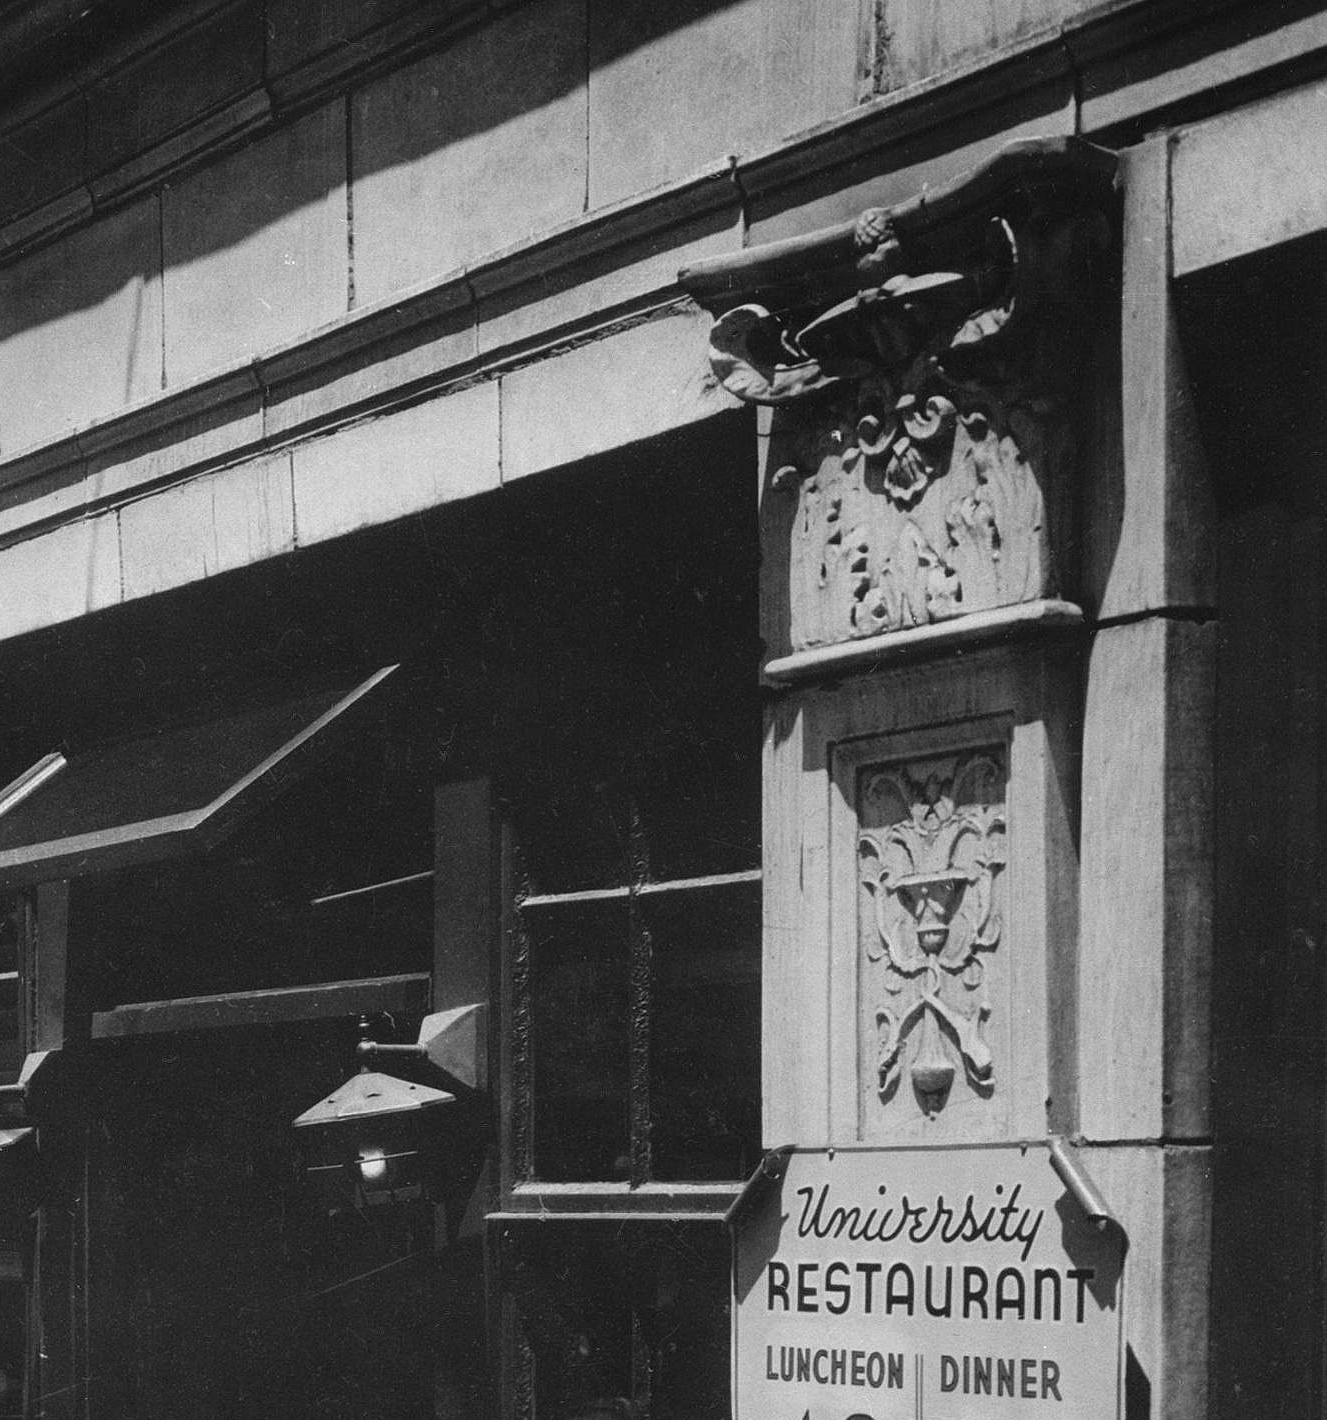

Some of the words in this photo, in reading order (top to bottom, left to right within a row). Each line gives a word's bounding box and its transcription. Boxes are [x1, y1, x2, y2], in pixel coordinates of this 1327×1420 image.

[797, 1182, 1045, 1262] University
[767, 1261, 1095, 1323] RESTAURANT
[766, 1345, 904, 1389] LUNCHEON
[941, 1355, 1063, 1401] DINNER
